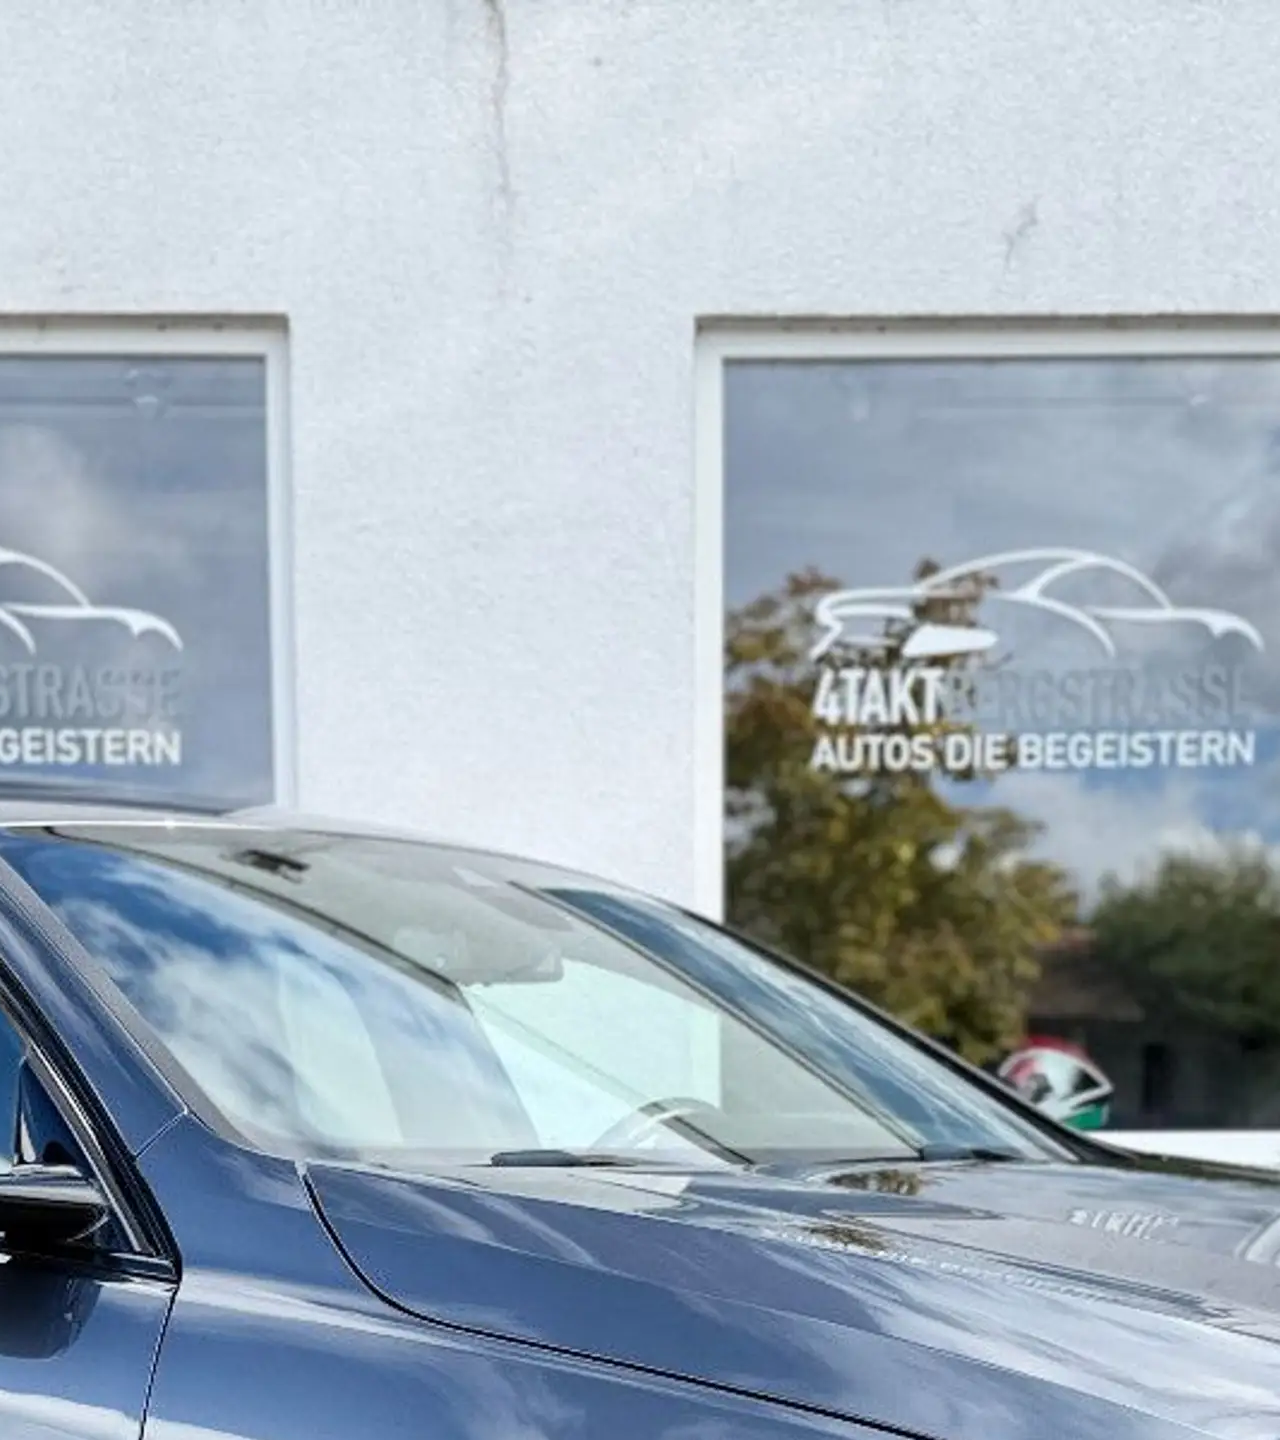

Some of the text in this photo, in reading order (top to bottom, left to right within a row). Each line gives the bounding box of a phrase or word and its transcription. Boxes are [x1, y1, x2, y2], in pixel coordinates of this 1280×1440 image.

[811, 730, 1256, 772] AUTOS DIE BEGEISTERN
